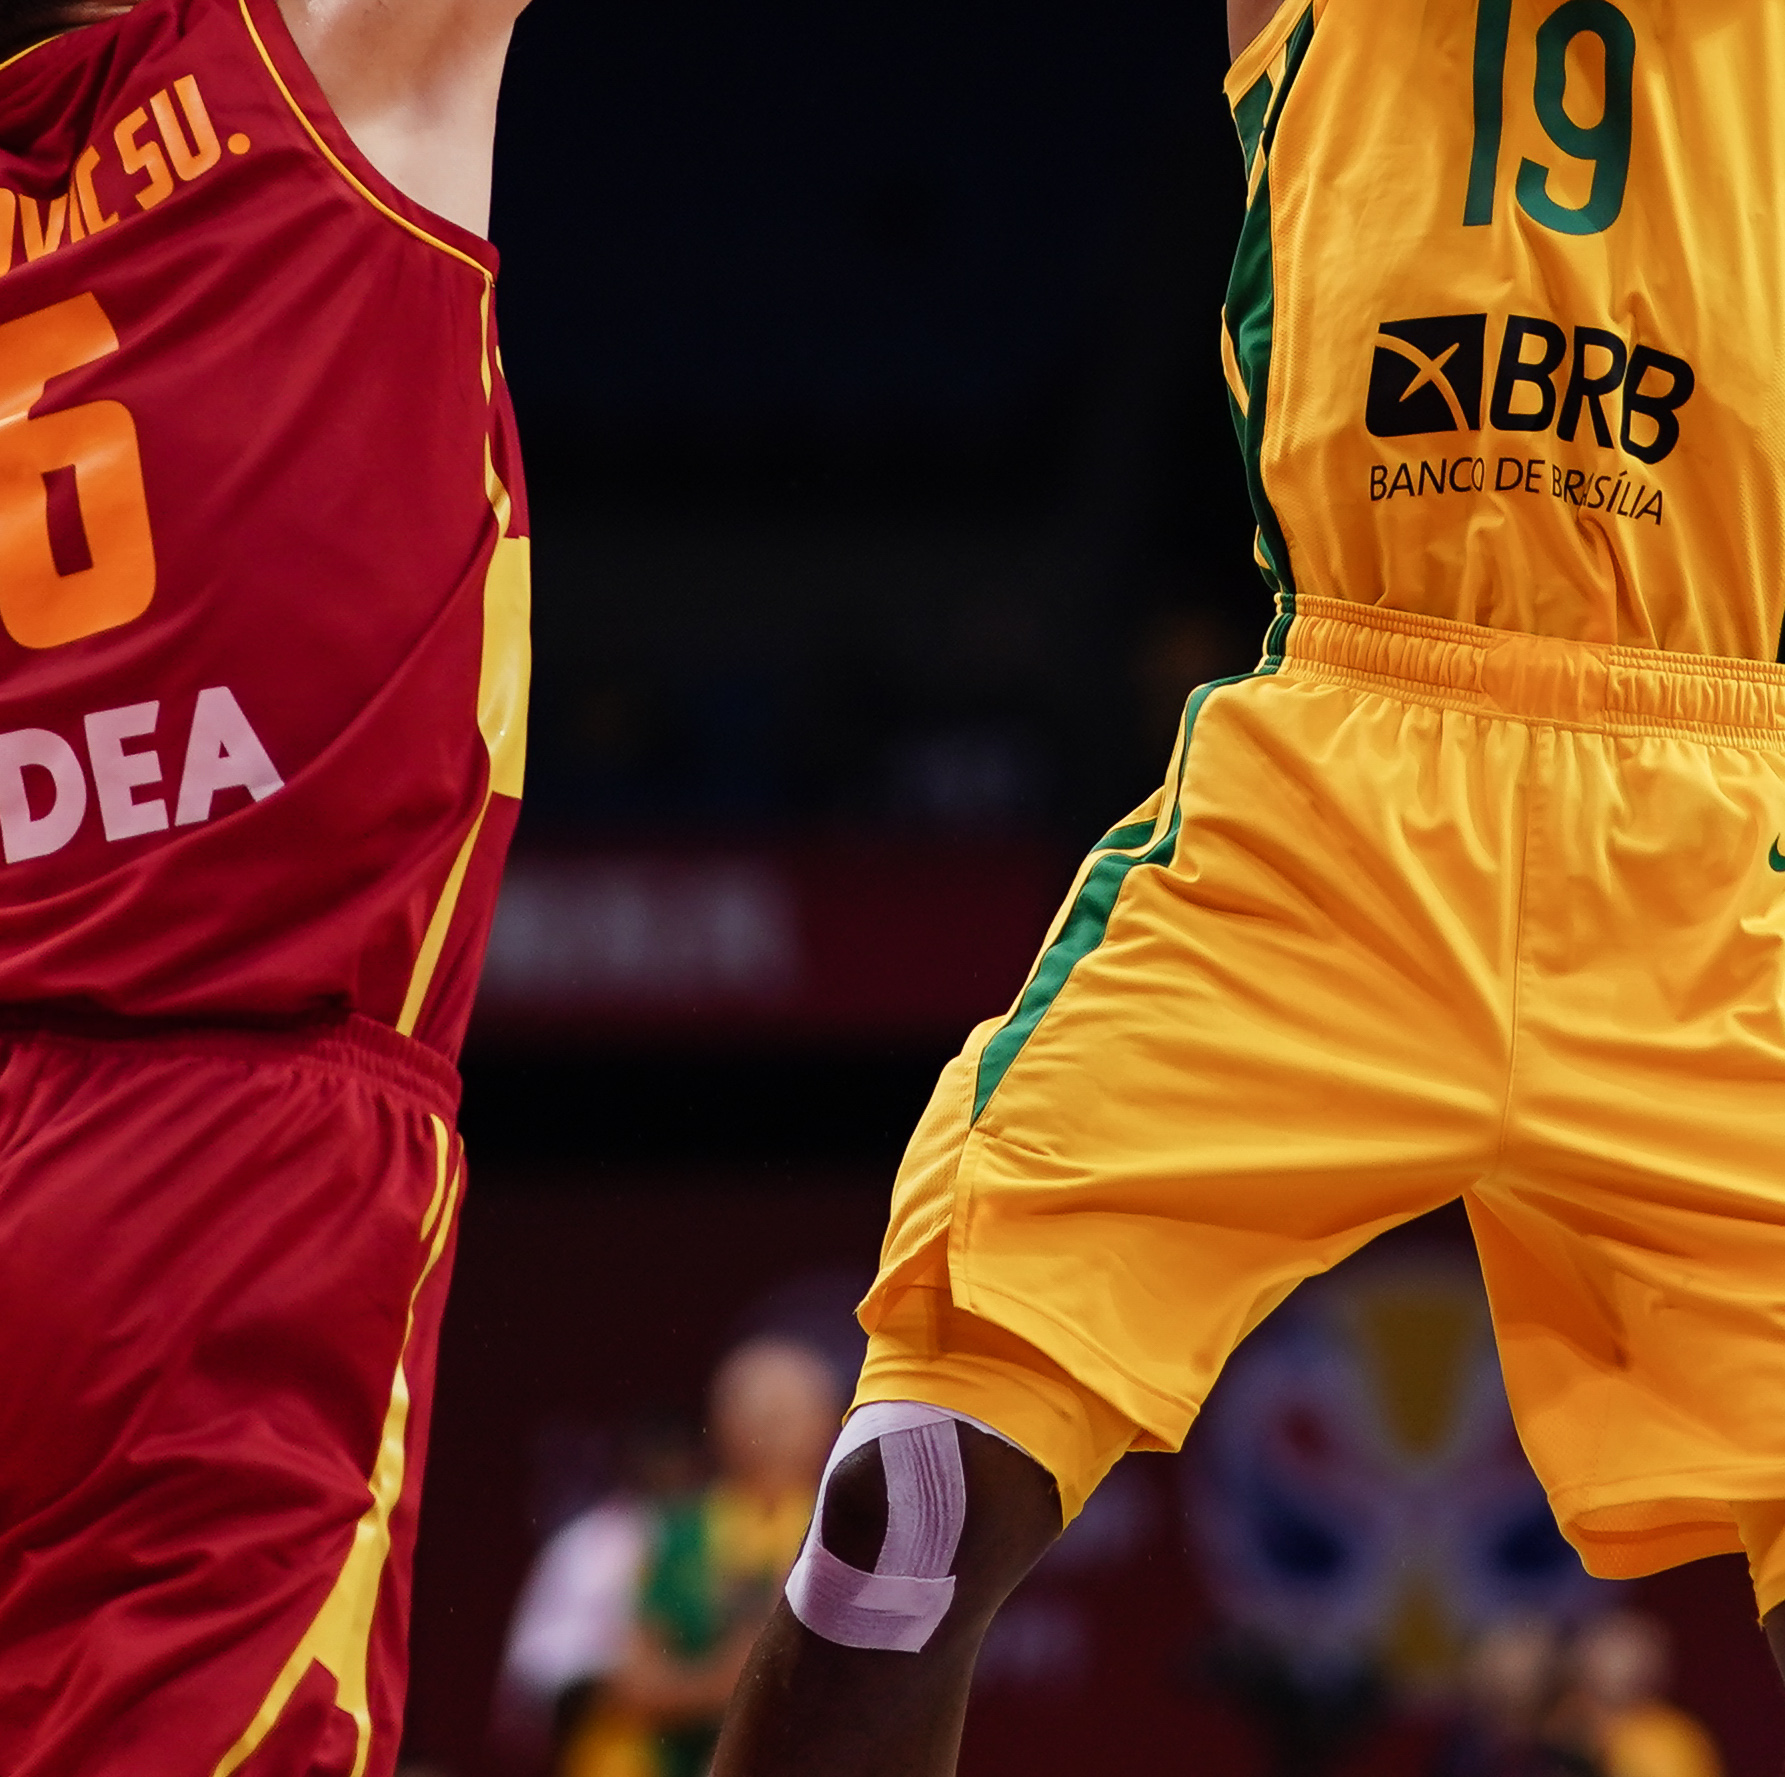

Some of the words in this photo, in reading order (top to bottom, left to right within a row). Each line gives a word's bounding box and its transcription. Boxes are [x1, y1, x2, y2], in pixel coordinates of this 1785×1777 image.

[113, 73, 252, 211] SU.
[1490, 313, 1696, 466] BRB
[1370, 456, 1485, 502] BANCO
[1495, 456, 1546, 494] DE
